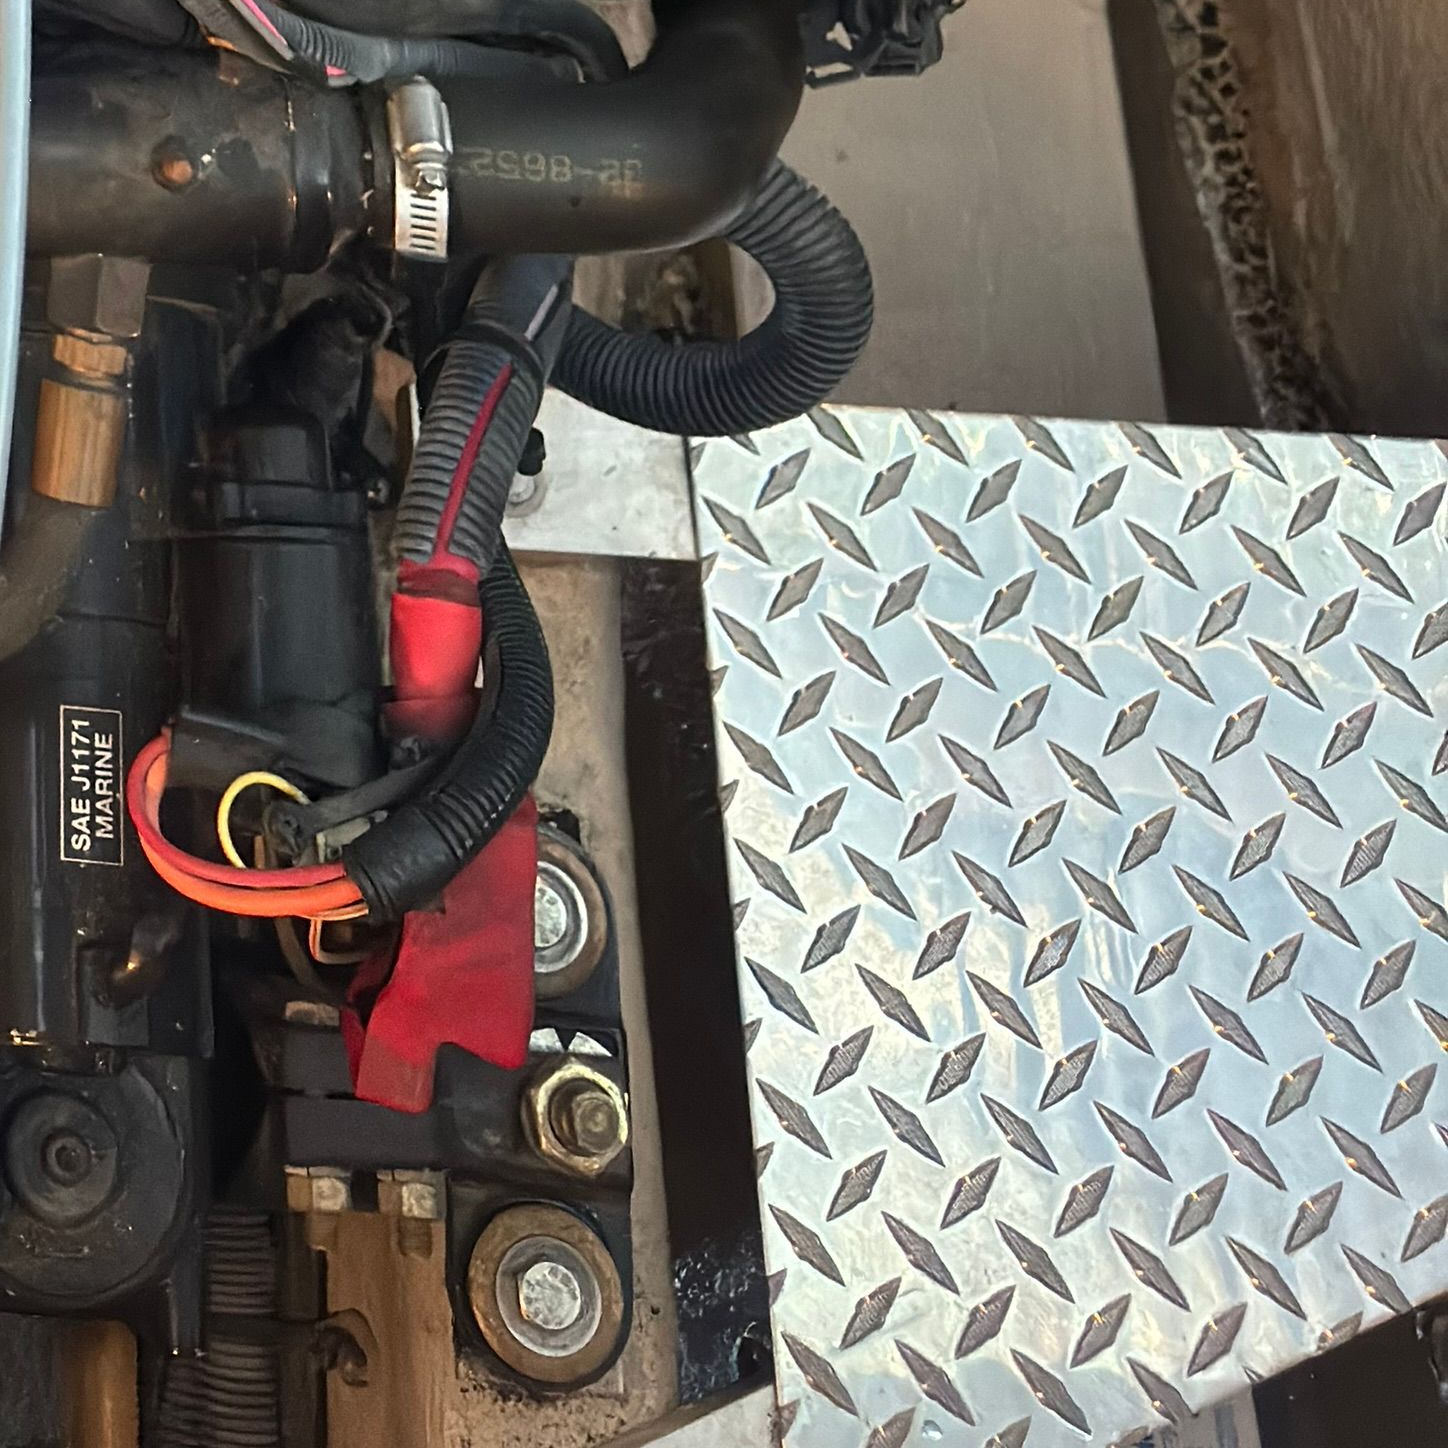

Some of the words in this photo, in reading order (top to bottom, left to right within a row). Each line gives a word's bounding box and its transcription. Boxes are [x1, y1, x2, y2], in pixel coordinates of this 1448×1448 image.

[70, 719, 91, 792] J1171
[94, 732, 115, 840] MARINE
[70, 797, 91, 852] SAE
